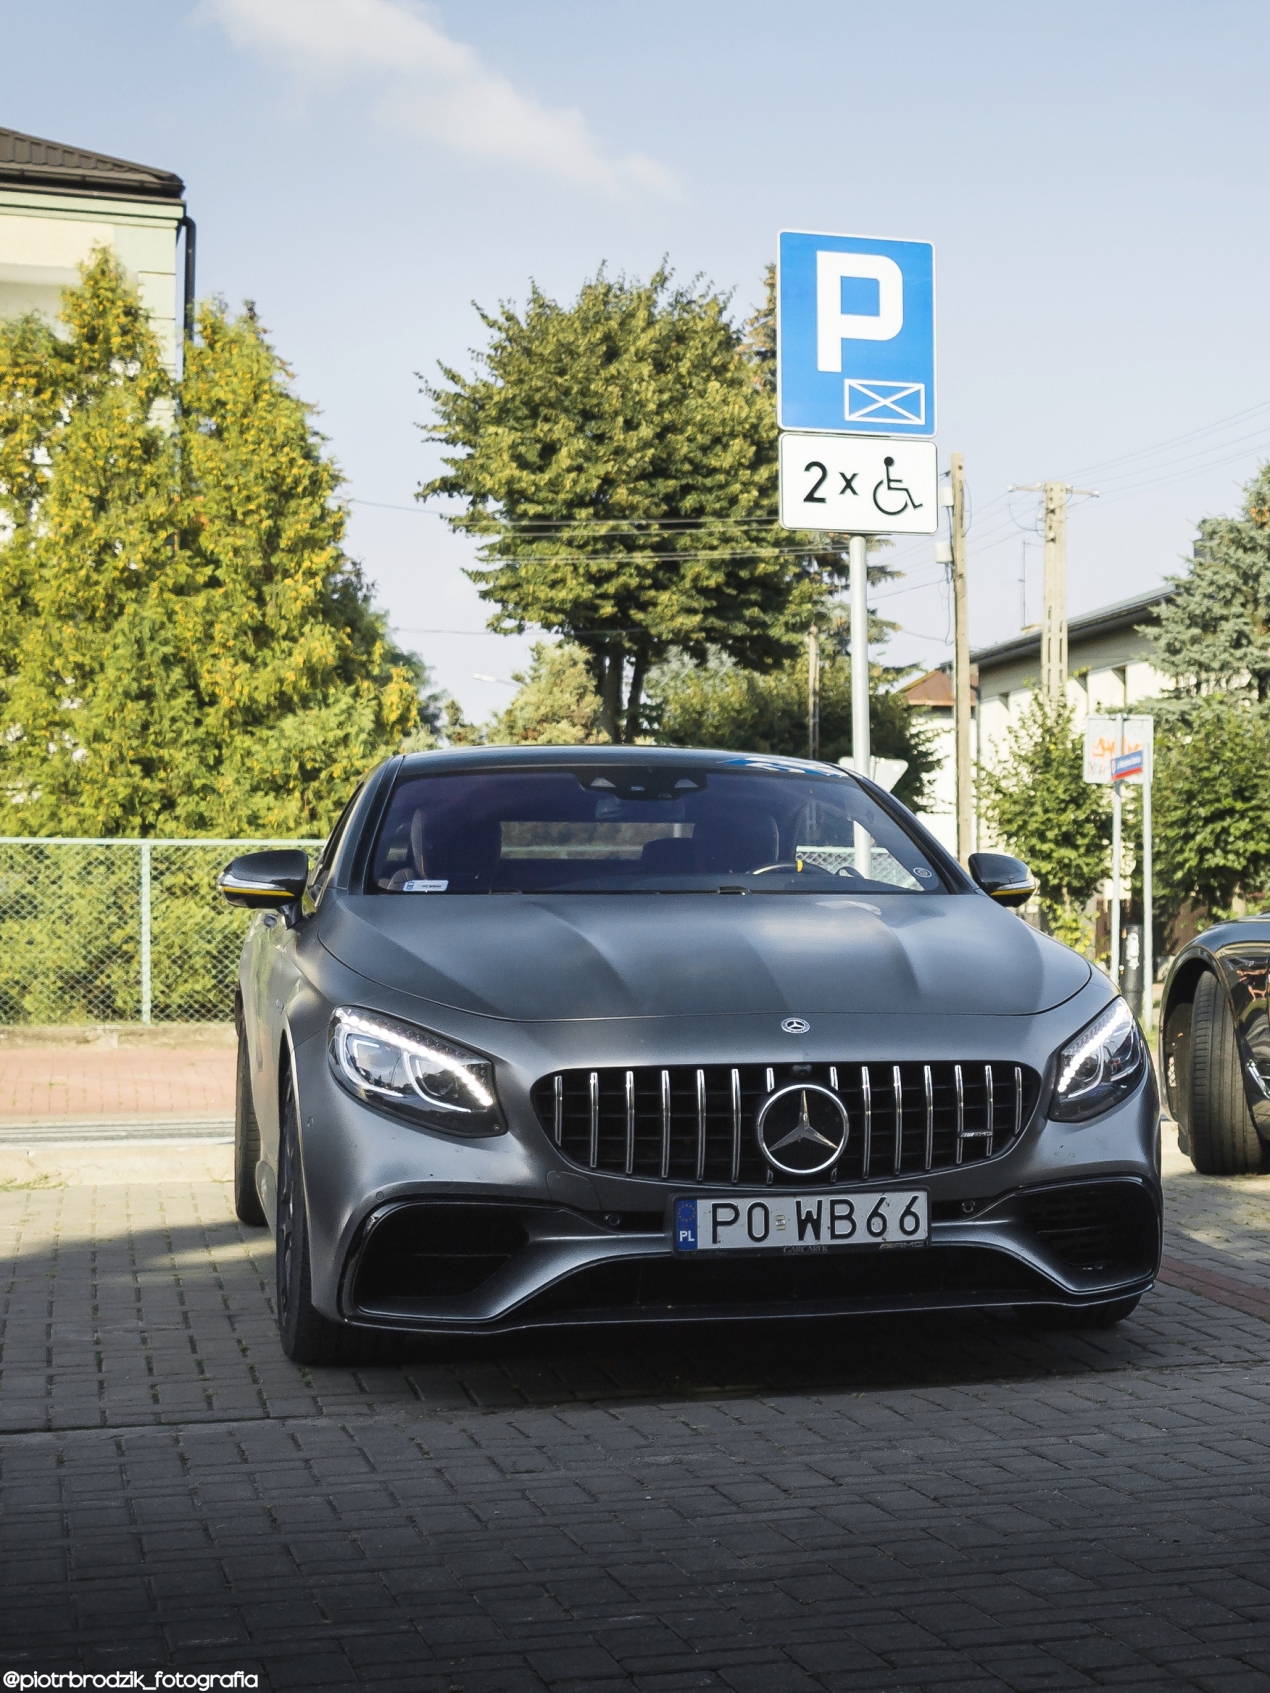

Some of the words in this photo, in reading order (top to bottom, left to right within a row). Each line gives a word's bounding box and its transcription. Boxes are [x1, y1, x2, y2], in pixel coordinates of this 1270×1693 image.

[816, 250, 904, 373] P
[803, 459, 828, 504] 2
[838, 471, 859, 497] x
[679, 1230, 696, 1243] PL
[711, 1201, 770, 1244] PO
[795, 1195, 921, 1242] WB66
